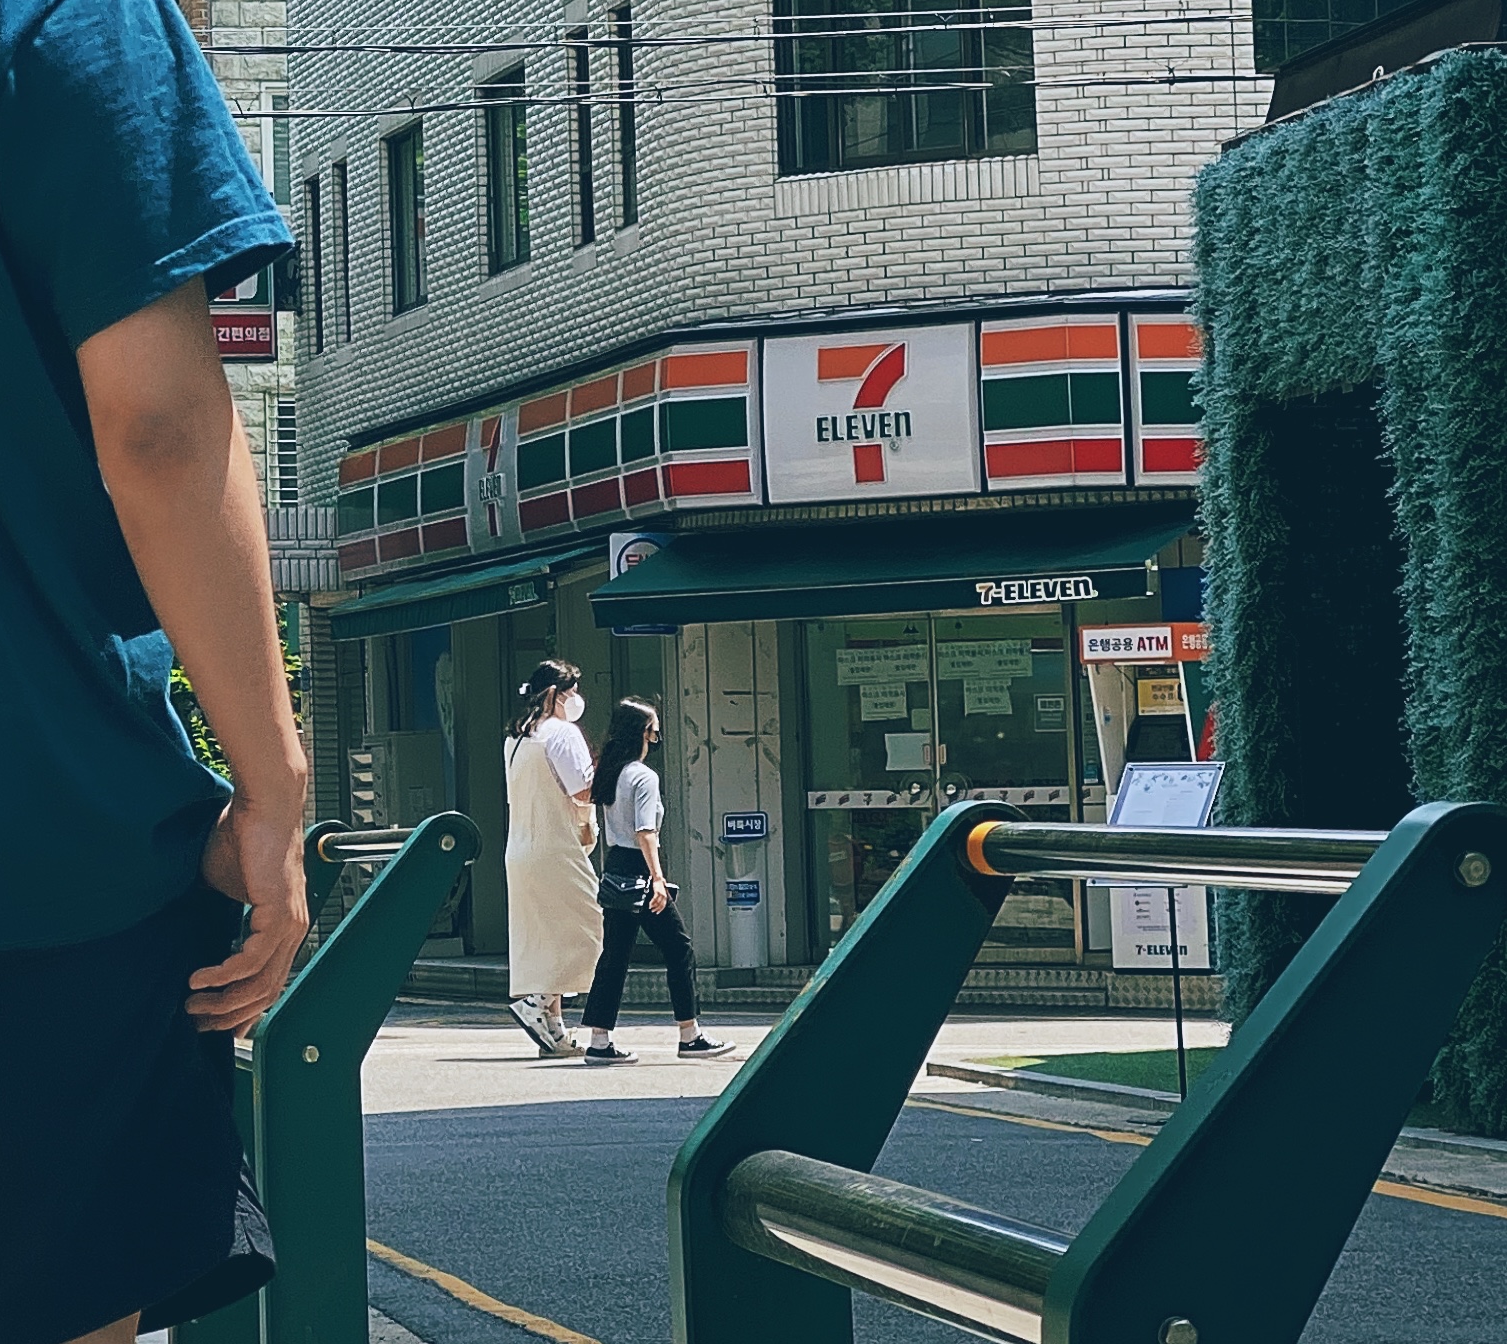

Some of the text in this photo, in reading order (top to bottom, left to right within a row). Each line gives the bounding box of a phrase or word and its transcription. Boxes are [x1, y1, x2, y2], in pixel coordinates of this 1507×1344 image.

[213, 327, 271, 342] 간편의점
[1088, 636, 1169, 652] 은행공용 ATM
